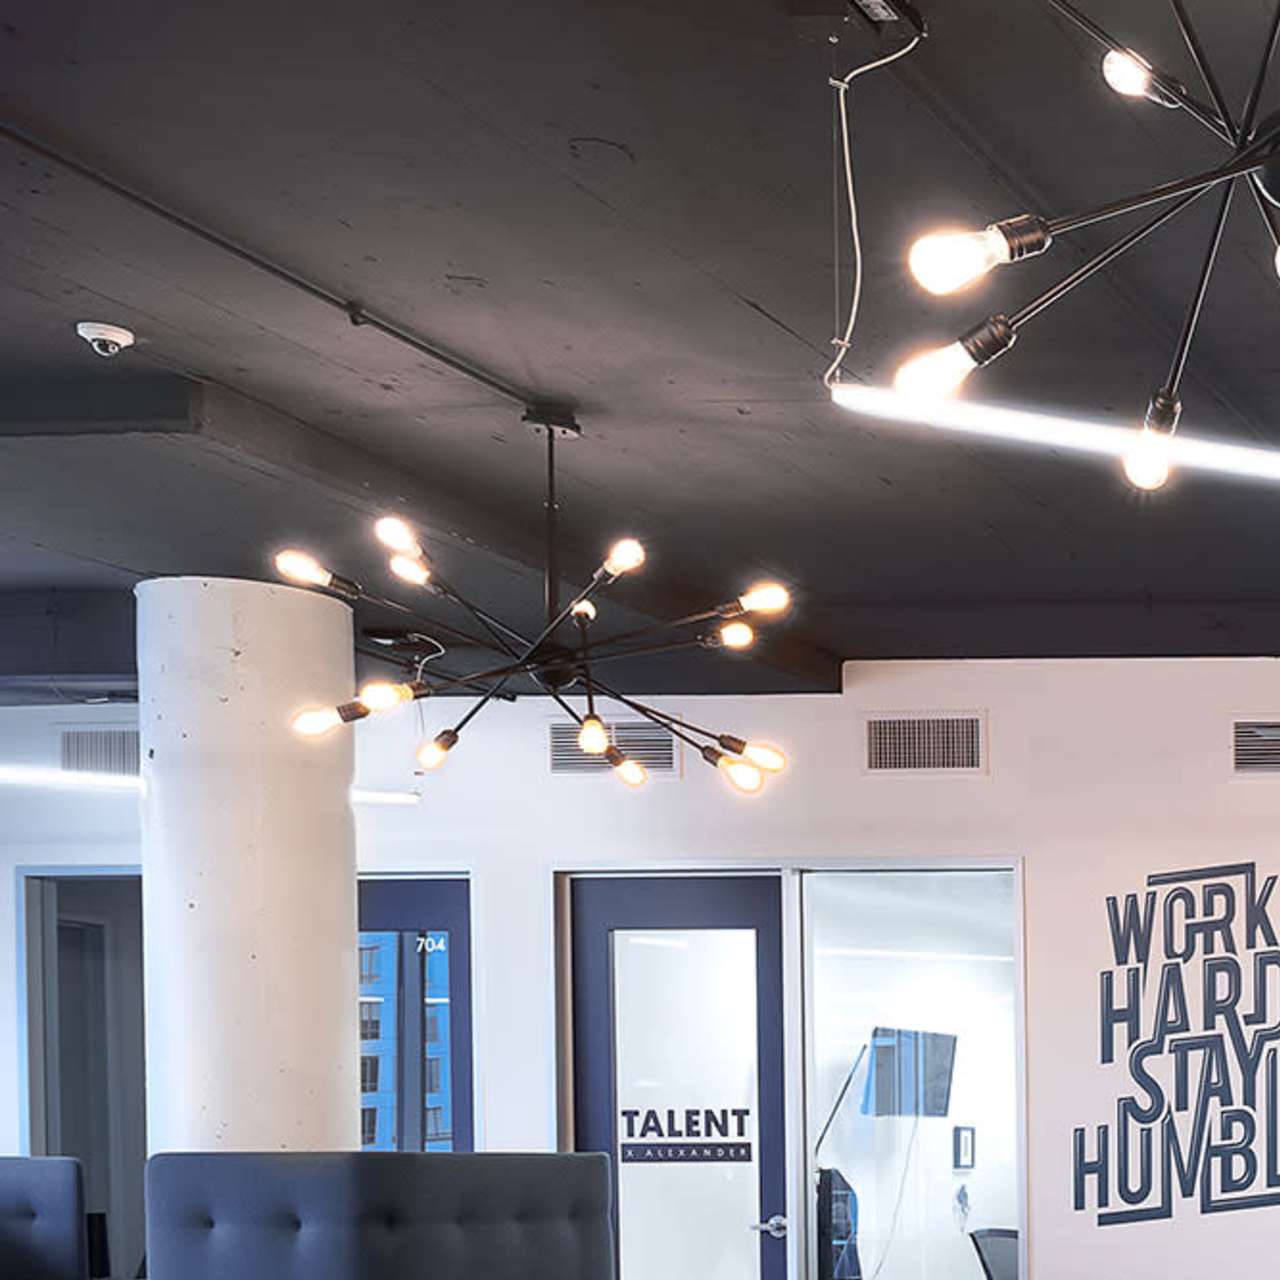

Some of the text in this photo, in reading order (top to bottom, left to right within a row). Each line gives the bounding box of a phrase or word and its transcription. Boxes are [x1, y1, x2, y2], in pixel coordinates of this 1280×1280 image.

[1105, 862, 1278, 967] WORK
[416, 936, 447, 953] 704
[1128, 1033, 1266, 1125] STAY
[621, 1109, 750, 1138] TALENT
[645, 1148, 746, 1158] ALEXANDER
